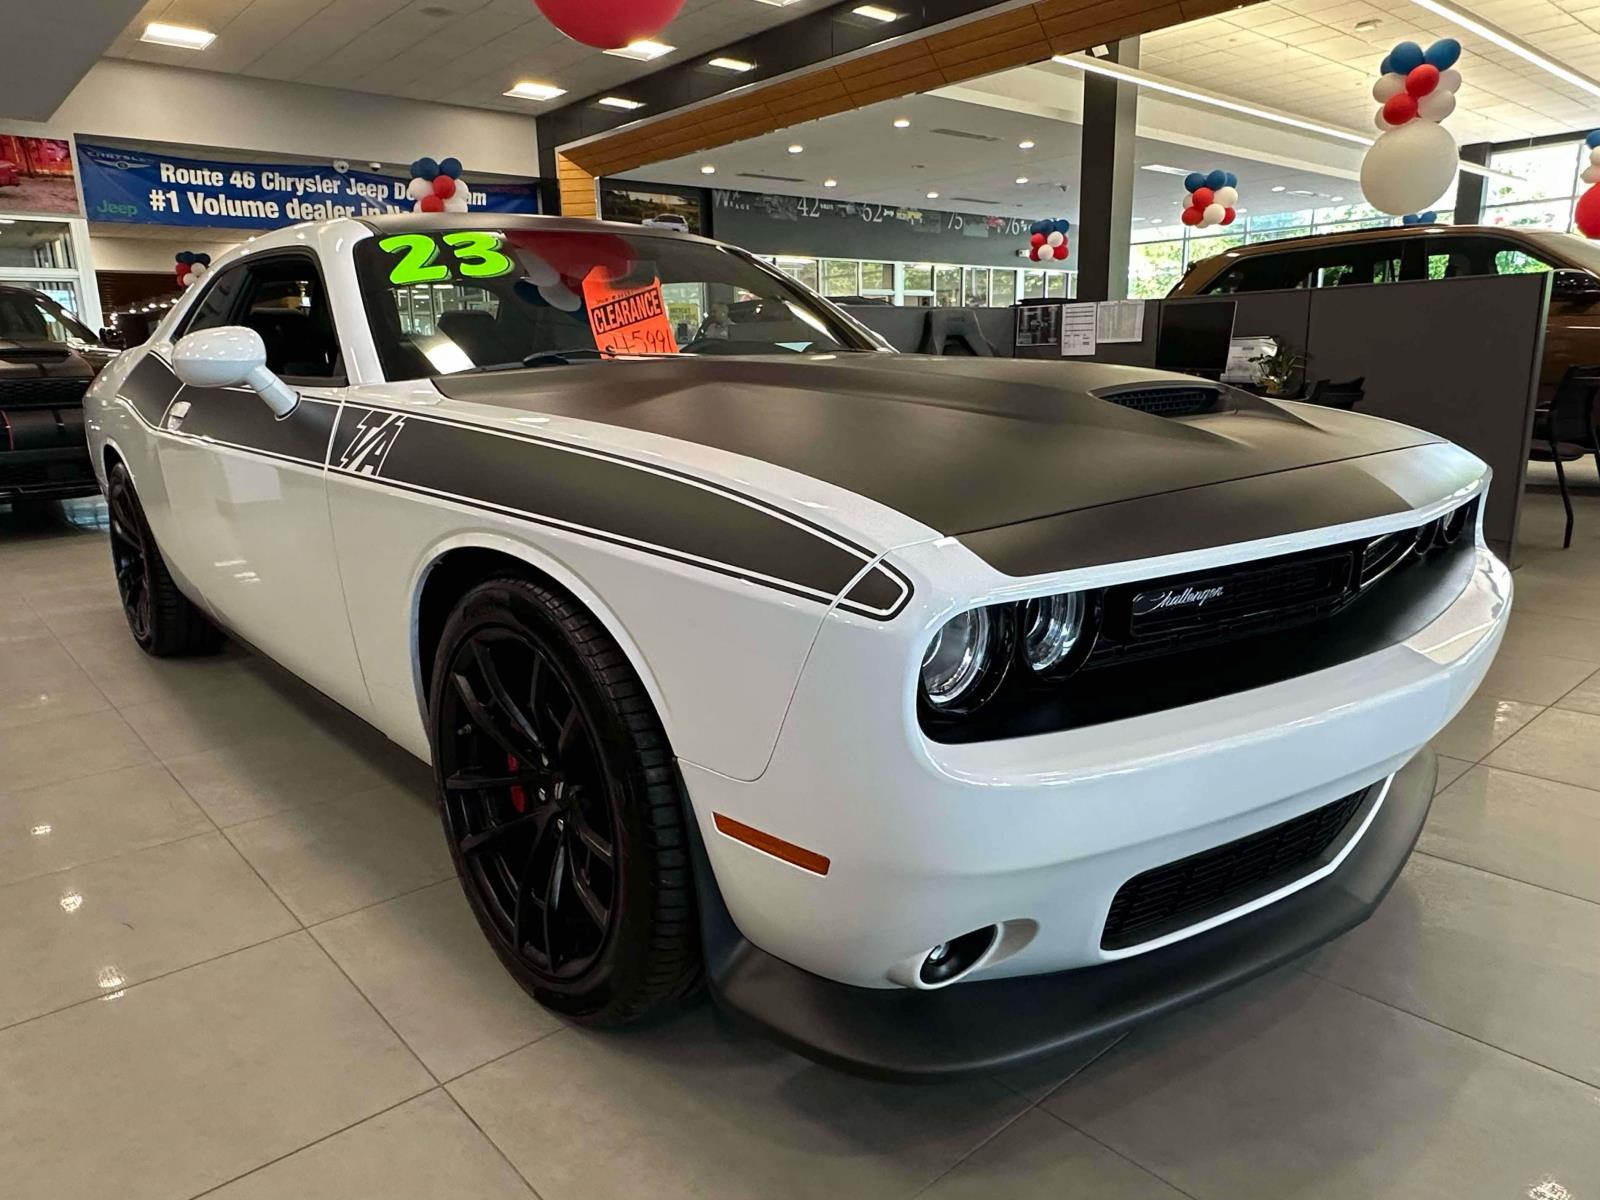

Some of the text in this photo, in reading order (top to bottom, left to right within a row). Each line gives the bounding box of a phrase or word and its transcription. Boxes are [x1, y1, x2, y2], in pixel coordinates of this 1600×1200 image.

[160, 163, 224, 187] Route
[229, 171, 256, 189] 46
[261, 172, 341, 196] Chrysler
[346, 177, 389, 202] Jeep
[96, 200, 137, 216] Jeep
[149, 190, 180, 213] #1
[186, 192, 280, 219] Volume
[285, 199, 355, 220] dealer
[379, 232, 514, 285] 23
[593, 290, 661, 334] CLEARANCE
[1132, 586, 1224, 615] Challenger
